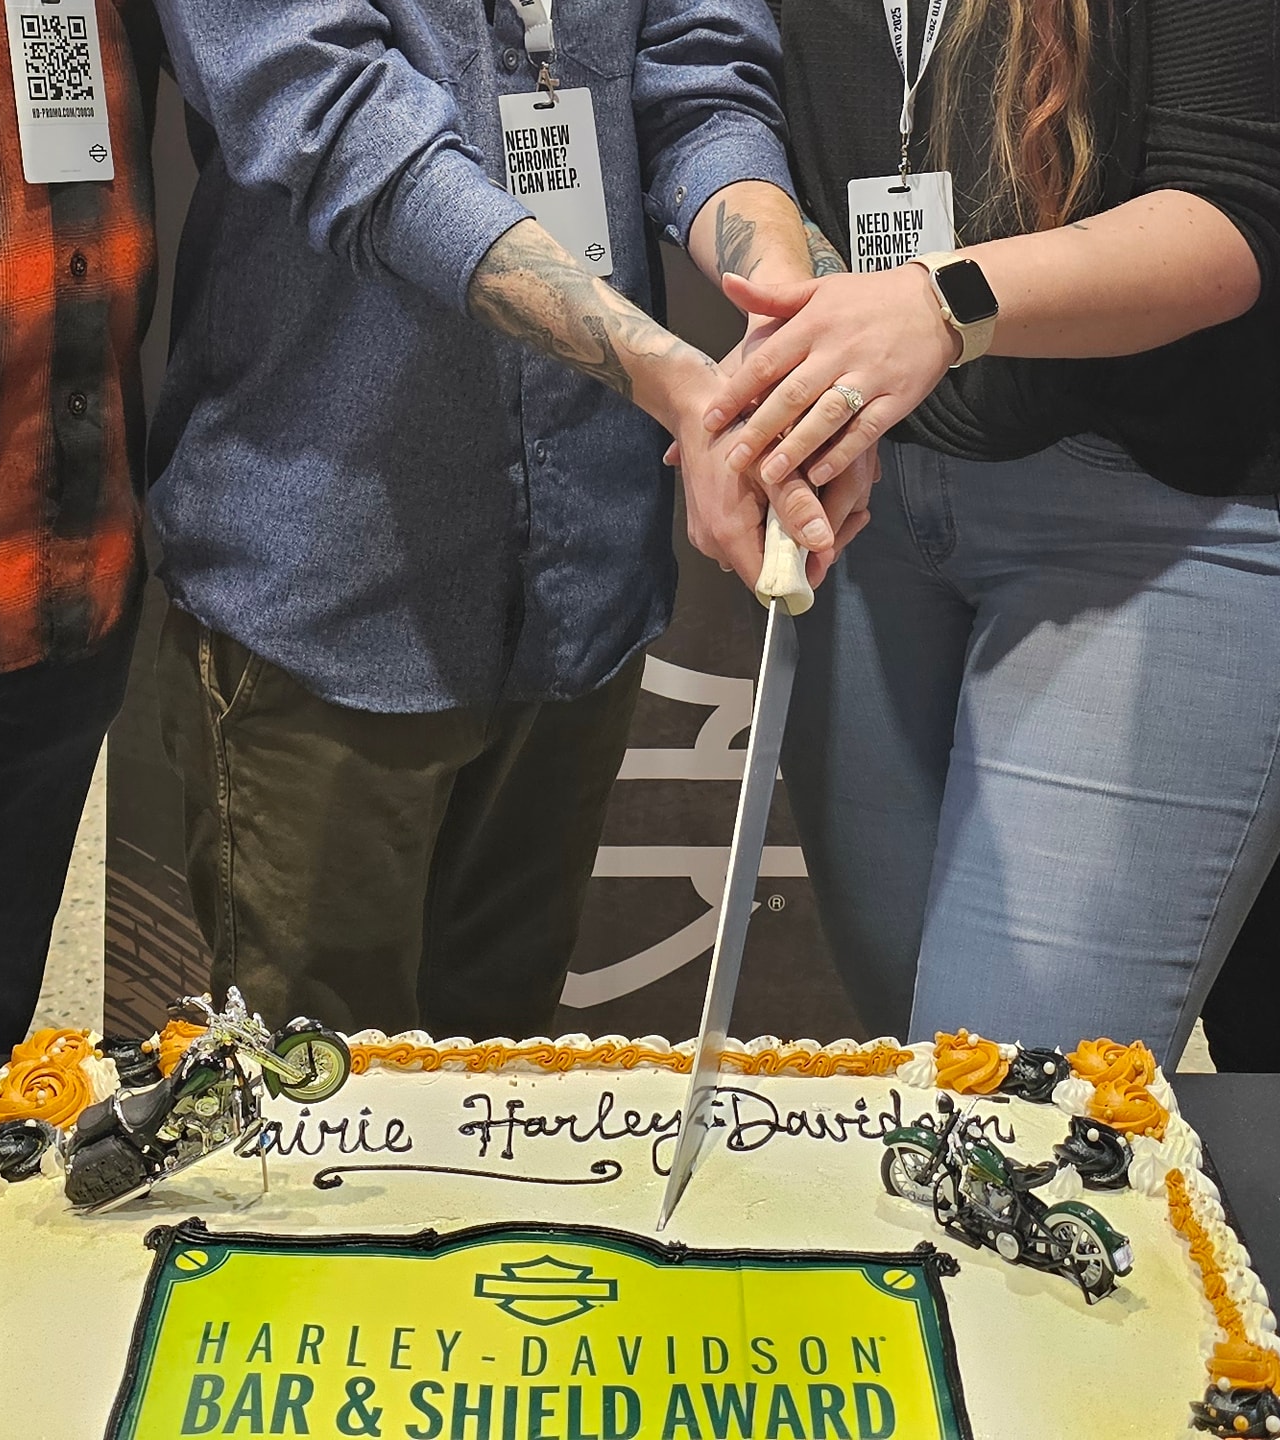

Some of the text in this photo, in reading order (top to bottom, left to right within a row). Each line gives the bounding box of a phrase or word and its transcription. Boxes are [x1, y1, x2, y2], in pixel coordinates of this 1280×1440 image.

[891, 6, 902, 31] 2025
[926, 18, 938, 43] 2025
[505, 124, 570, 152] NEED NEW
[508, 146, 567, 174] CHROME?
[510, 167, 580, 195] I CAN HELP.
[856, 209, 923, 234] NEED NEW
[857, 232, 919, 257] CHROME?
[866, 256, 892, 273] CAN
[235, 1107, 413, 1158] airie
[197, 1321, 880, 1377] HARLEY-DAVIDSON
[178, 1372, 896, 1440] BAR & SHIELD AWARD
